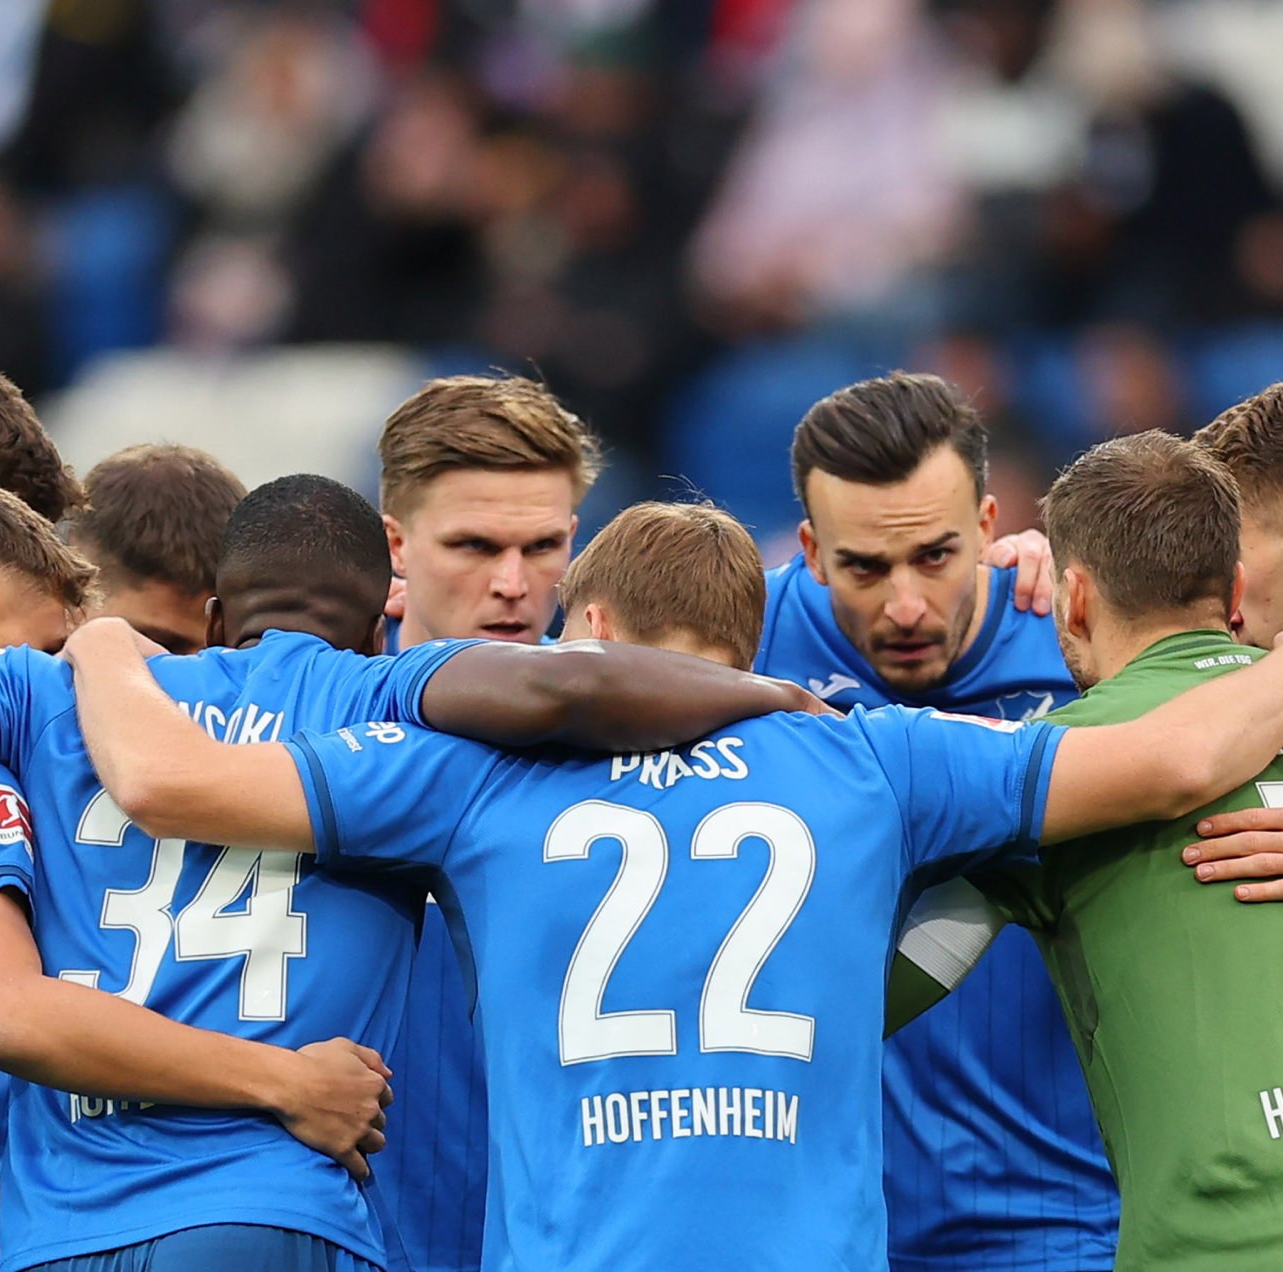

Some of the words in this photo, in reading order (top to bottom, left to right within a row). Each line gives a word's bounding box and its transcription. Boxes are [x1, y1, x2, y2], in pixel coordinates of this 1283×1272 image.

[610, 736, 749, 790] PRASS
[57, 788, 308, 1021] 34
[542, 799, 816, 1066] 22
[580, 1087, 799, 1147] HOFFENHEIM
